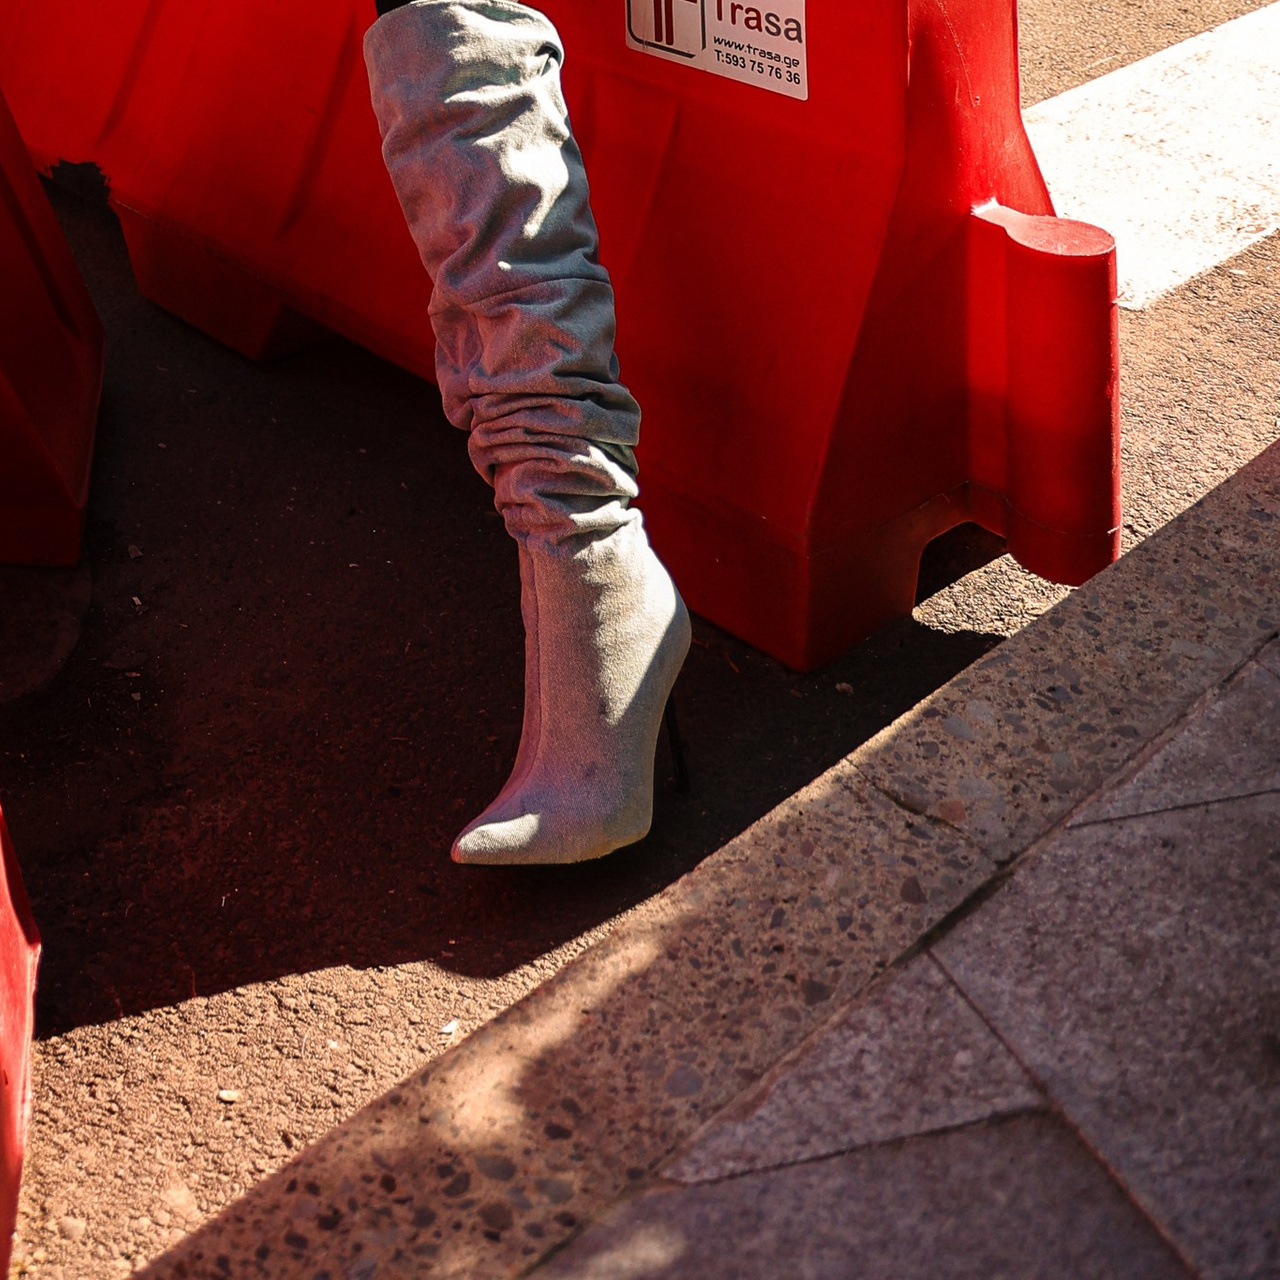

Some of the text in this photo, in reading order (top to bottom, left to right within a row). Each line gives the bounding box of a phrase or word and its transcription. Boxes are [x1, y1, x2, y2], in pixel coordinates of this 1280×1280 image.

[713, 35, 800, 69] www.trasa.ge
[714, 48, 801, 85] T:593 75 76 36
